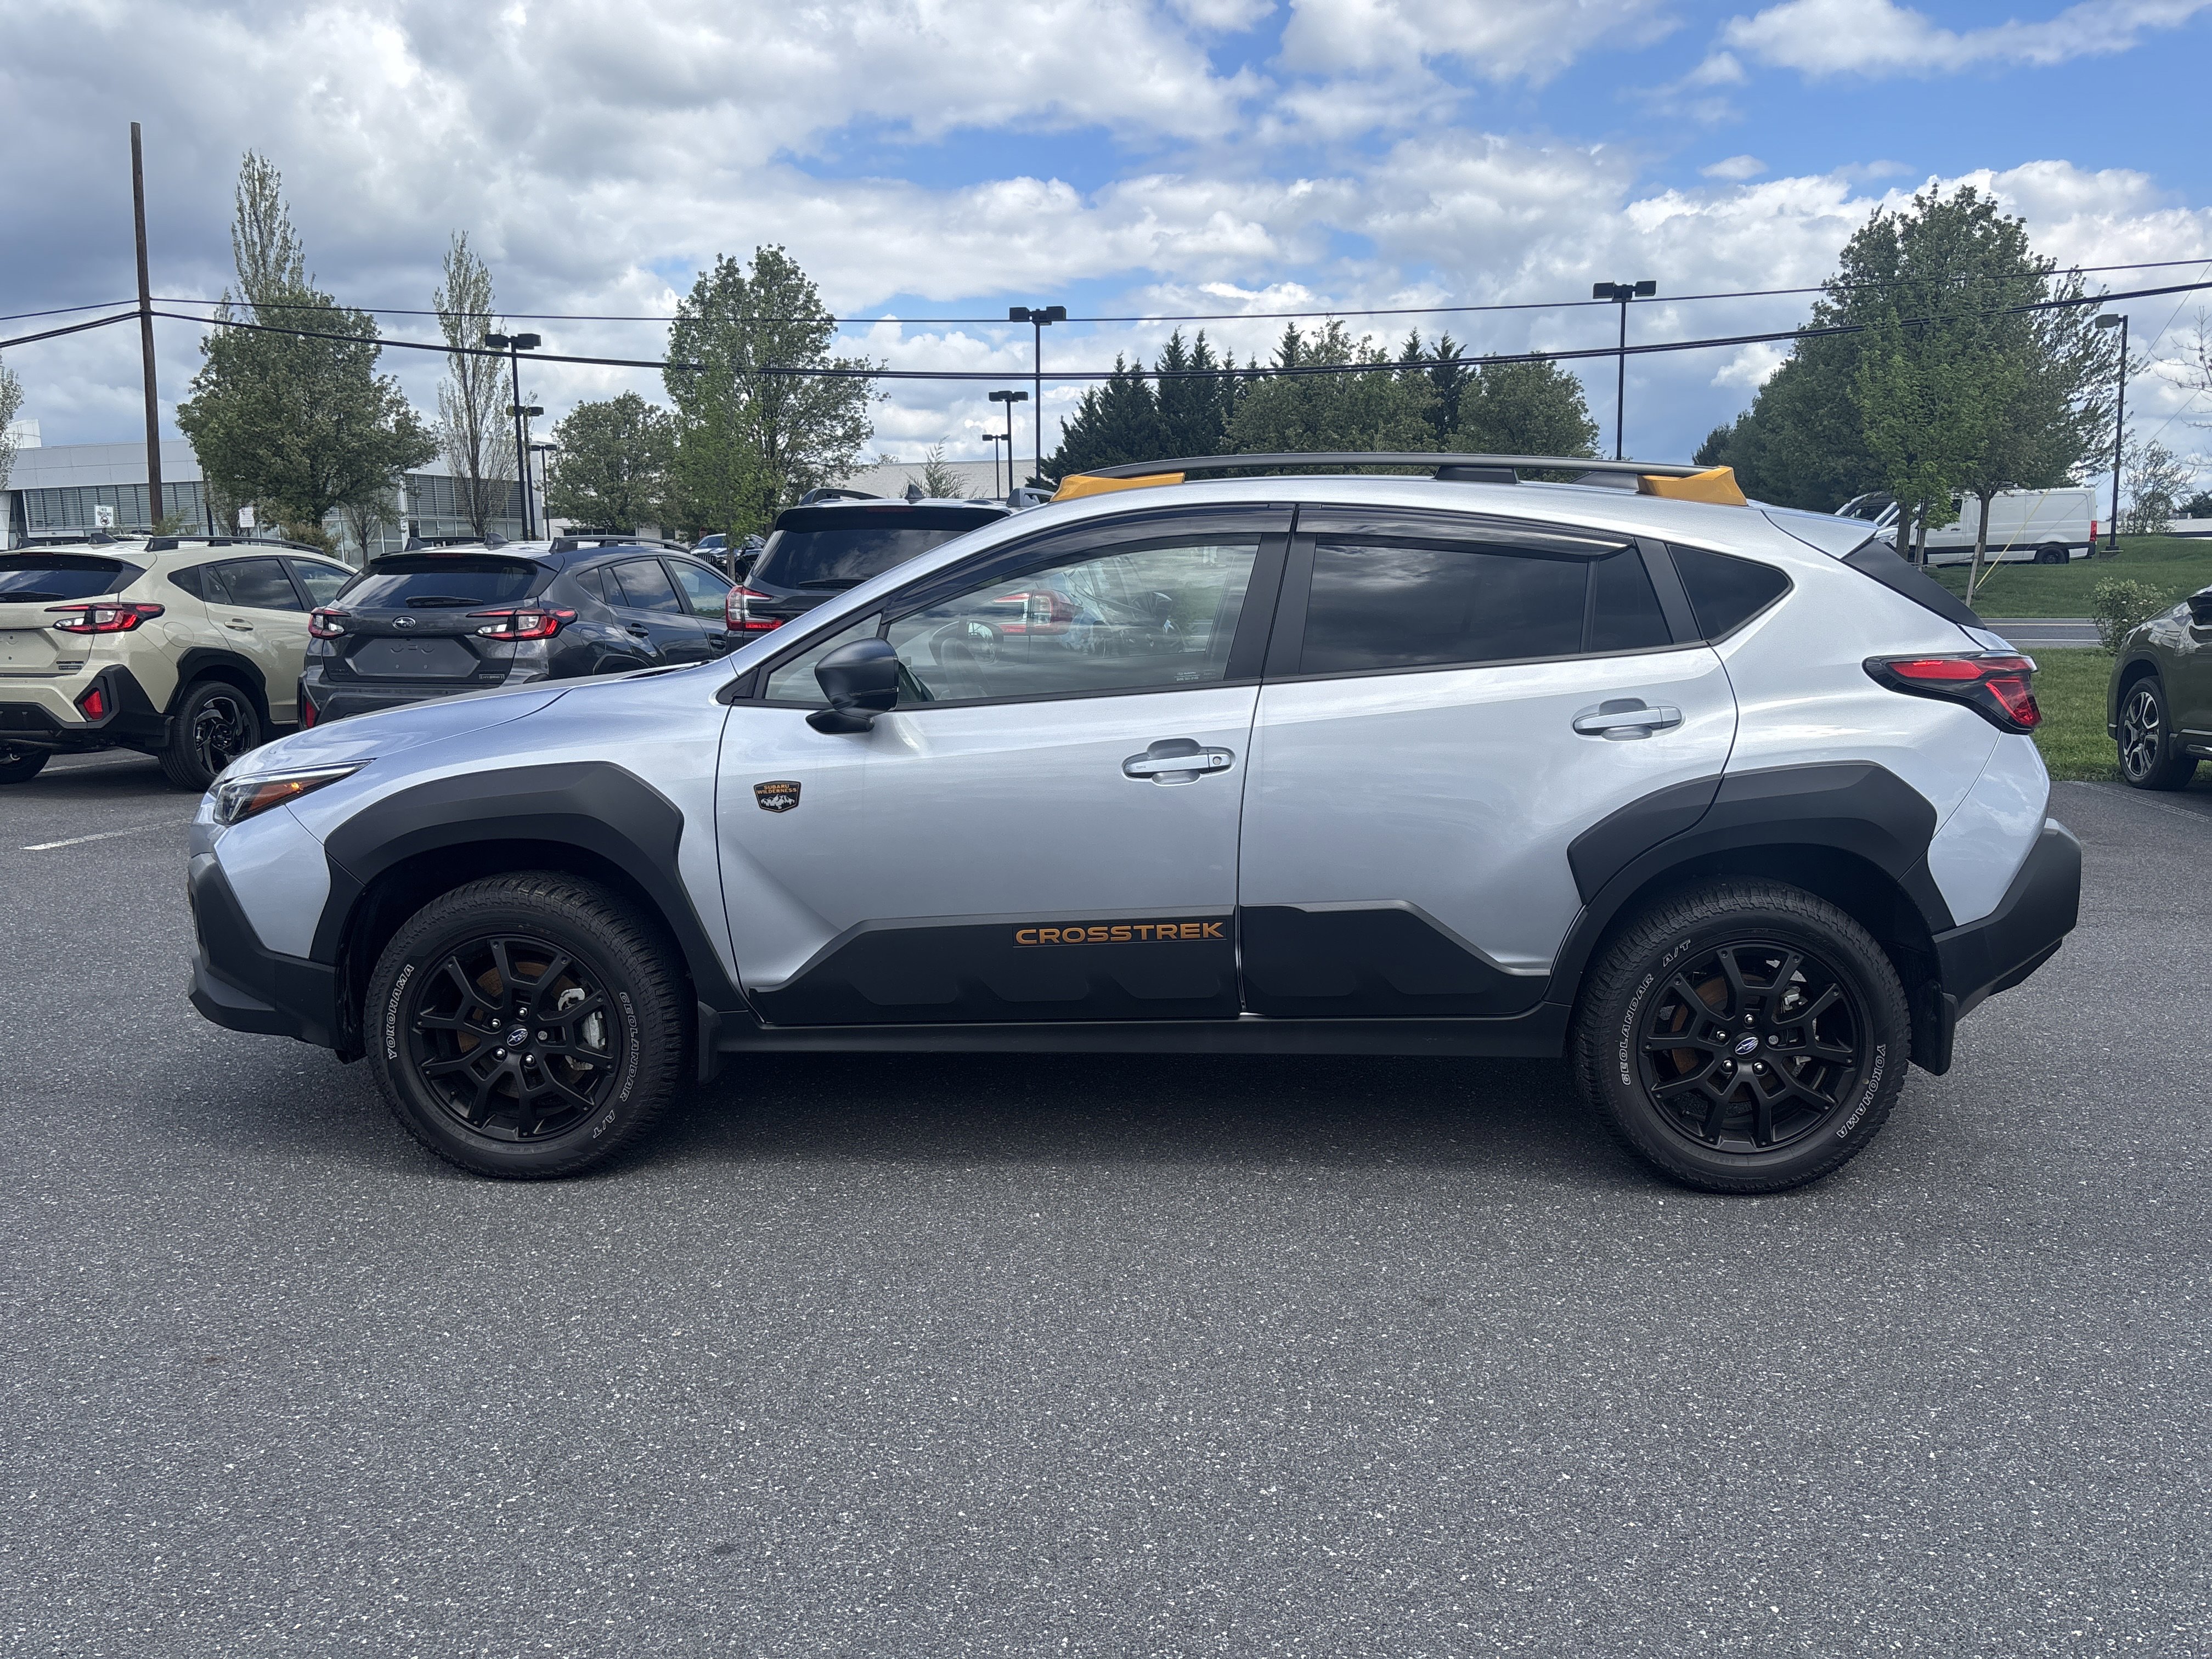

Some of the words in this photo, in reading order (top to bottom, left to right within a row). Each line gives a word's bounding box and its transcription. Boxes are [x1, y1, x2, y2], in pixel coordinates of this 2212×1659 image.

[1015, 922, 1224, 945] CROSSTREK
[386, 963, 415, 1060] YOKOHAMA
[619, 991, 640, 1102] GEOLANDAR
[1619, 973, 1654, 1085] GEOLANDAR
[1662, 939, 1691, 968] A/T
[592, 1109, 616, 1139] A/T
[1836, 1043, 1886, 1138] YOKOHAMA
